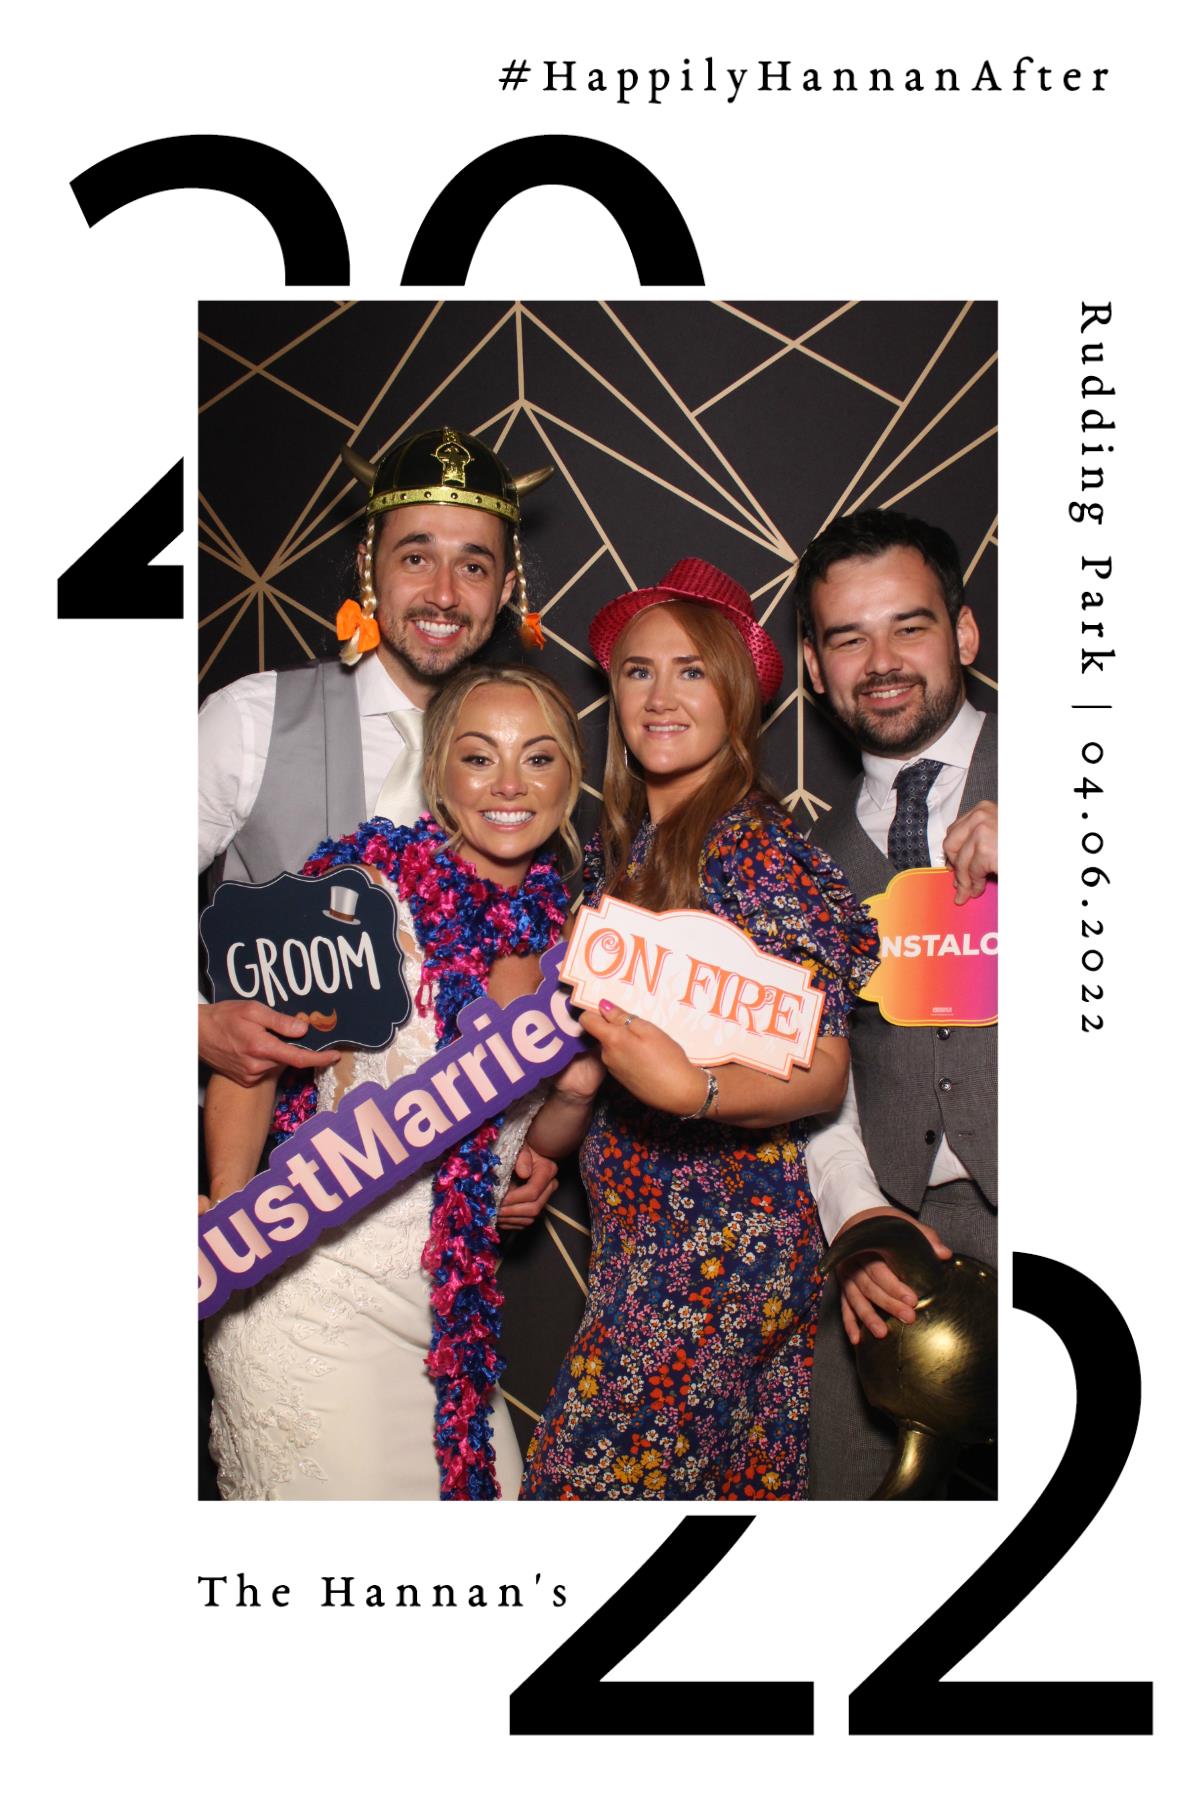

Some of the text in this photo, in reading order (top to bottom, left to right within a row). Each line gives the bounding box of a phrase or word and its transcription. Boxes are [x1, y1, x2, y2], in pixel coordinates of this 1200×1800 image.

[226, 931, 381, 1007] GROOM
[880, 931, 998, 958] NSTALO
[584, 927, 804, 1043] ON FIRE
